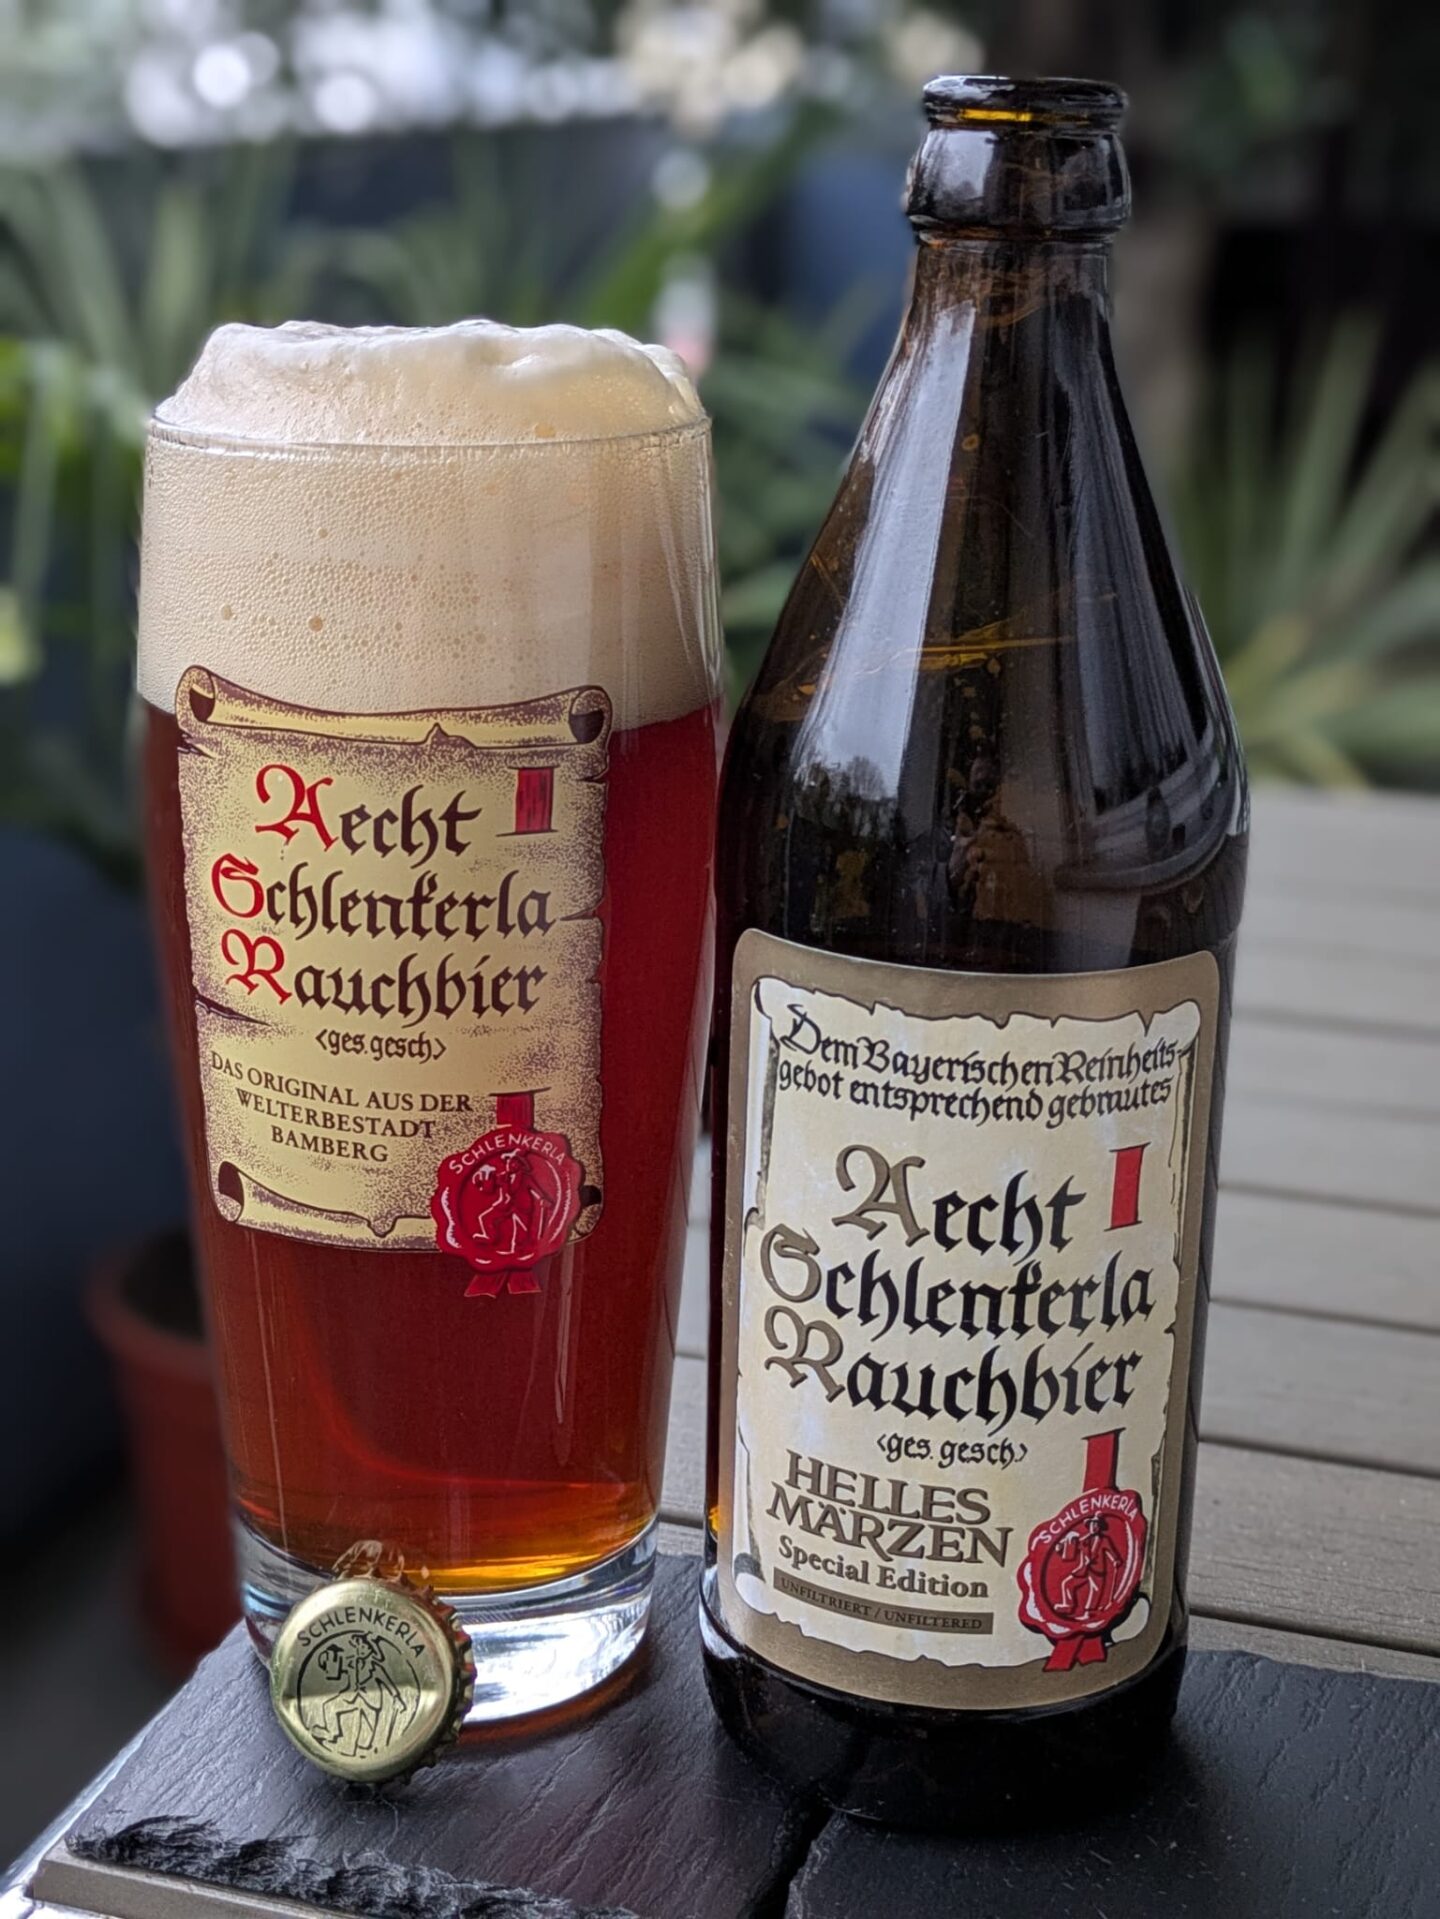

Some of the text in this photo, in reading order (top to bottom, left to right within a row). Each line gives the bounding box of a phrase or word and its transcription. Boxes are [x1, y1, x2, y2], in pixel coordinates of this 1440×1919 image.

[254, 763, 483, 869] Aecht
[210, 852, 557, 942] Schlenkerla
[220, 928, 548, 1028] Rauchbier
[210, 1050, 473, 1113] DAS ORIGINAL AUS DER
[779, 1003, 858, 1070] Dem
[856, 1036, 1054, 1091] Bayerischen
[235, 1087, 437, 1139] WELTERBESTADT
[779, 1060, 1174, 1129] gebot entsprechend gebrautes
[271, 1125, 389, 1163] BAMBERG
[448, 1133, 565, 1175] SCHLENKERLA
[832, 1143, 1087, 1265] Aecht
[760, 1222, 1156, 1341] Schlenkerla
[764, 1304, 1143, 1437] Rauchbier
[785, 1449, 992, 1525] HELLES
[1039, 1494, 1139, 1545] SCHLENKERLA
[766, 1481, 1015, 1568] MÄRZEN
[778, 1534, 989, 1599] Special Edition
[297, 1606, 427, 1659] SCHLENKERLA
[780, 1577, 872, 1616] UNFILTRIERT
[884, 1611, 983, 1630] UNFILTERED
